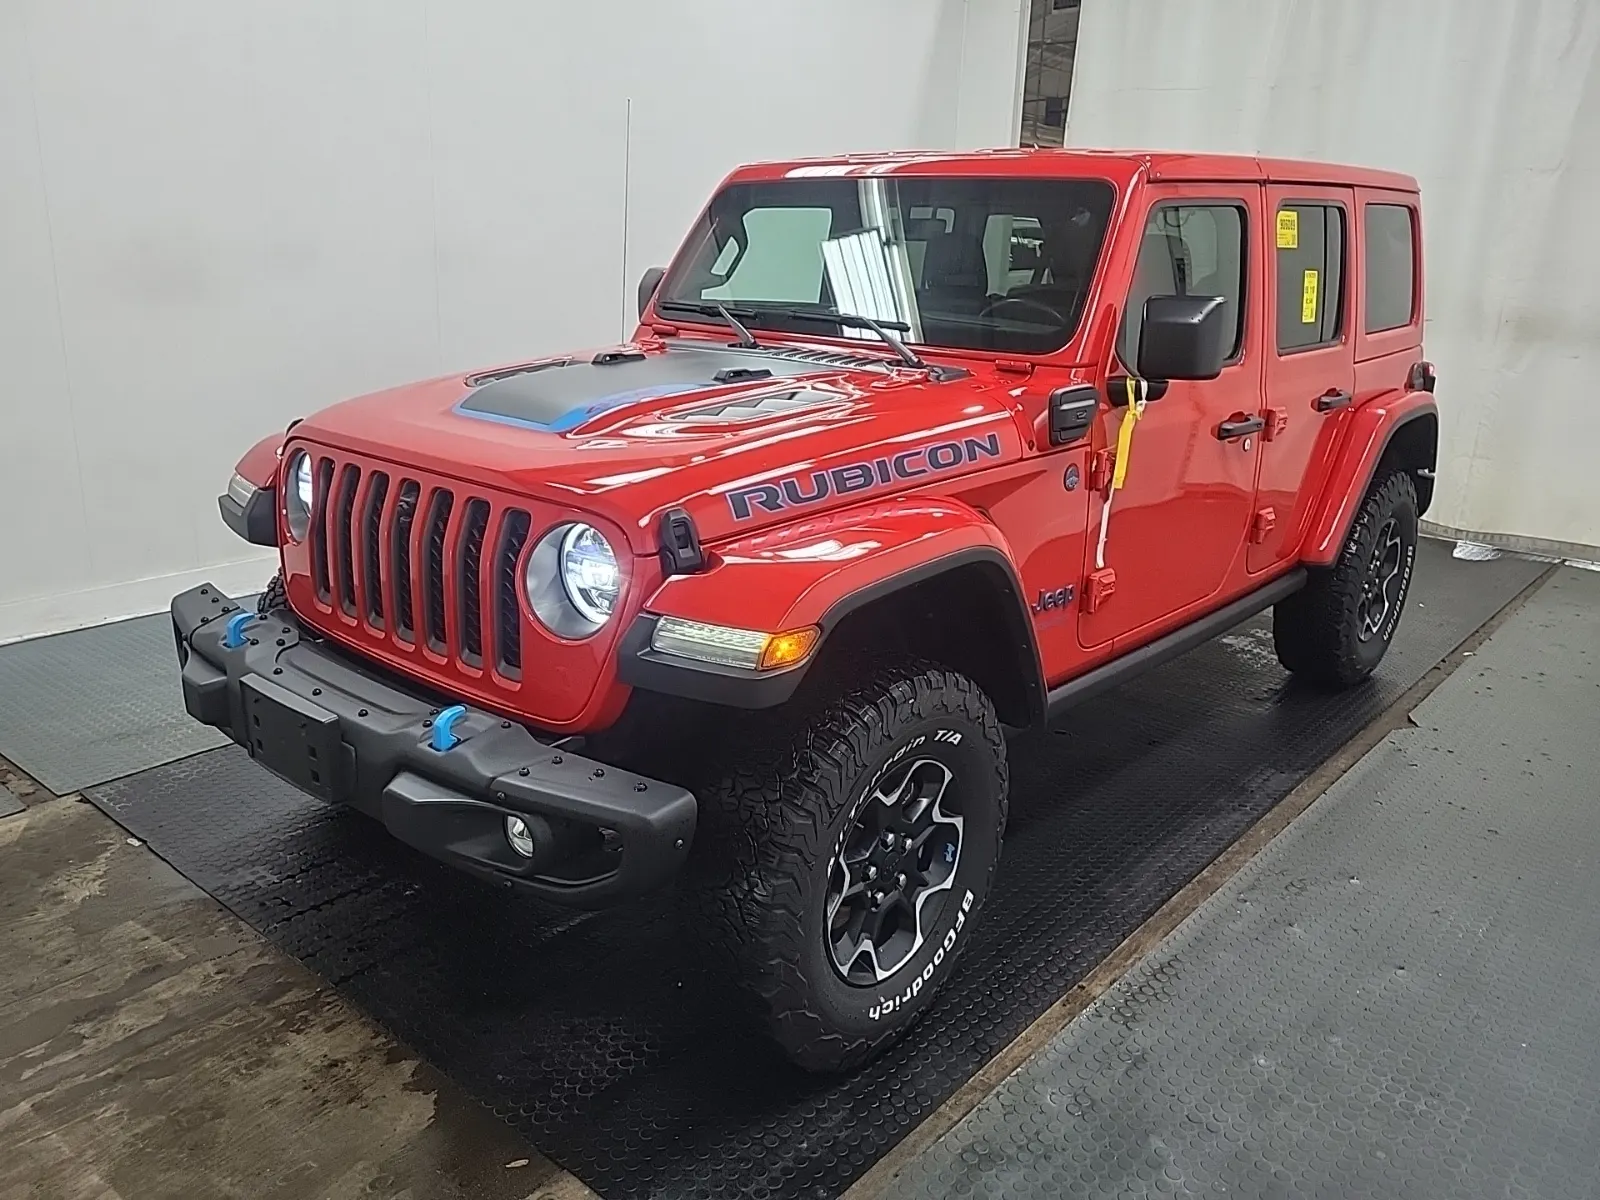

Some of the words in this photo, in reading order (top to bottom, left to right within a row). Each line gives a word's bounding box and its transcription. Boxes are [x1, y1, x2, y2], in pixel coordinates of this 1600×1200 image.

[724, 431, 1002, 522] RUBICON
[1030, 584, 1076, 617] Jeep
[933, 729, 964, 746] T/A
[868, 888, 975, 1020] BFGoodrich
